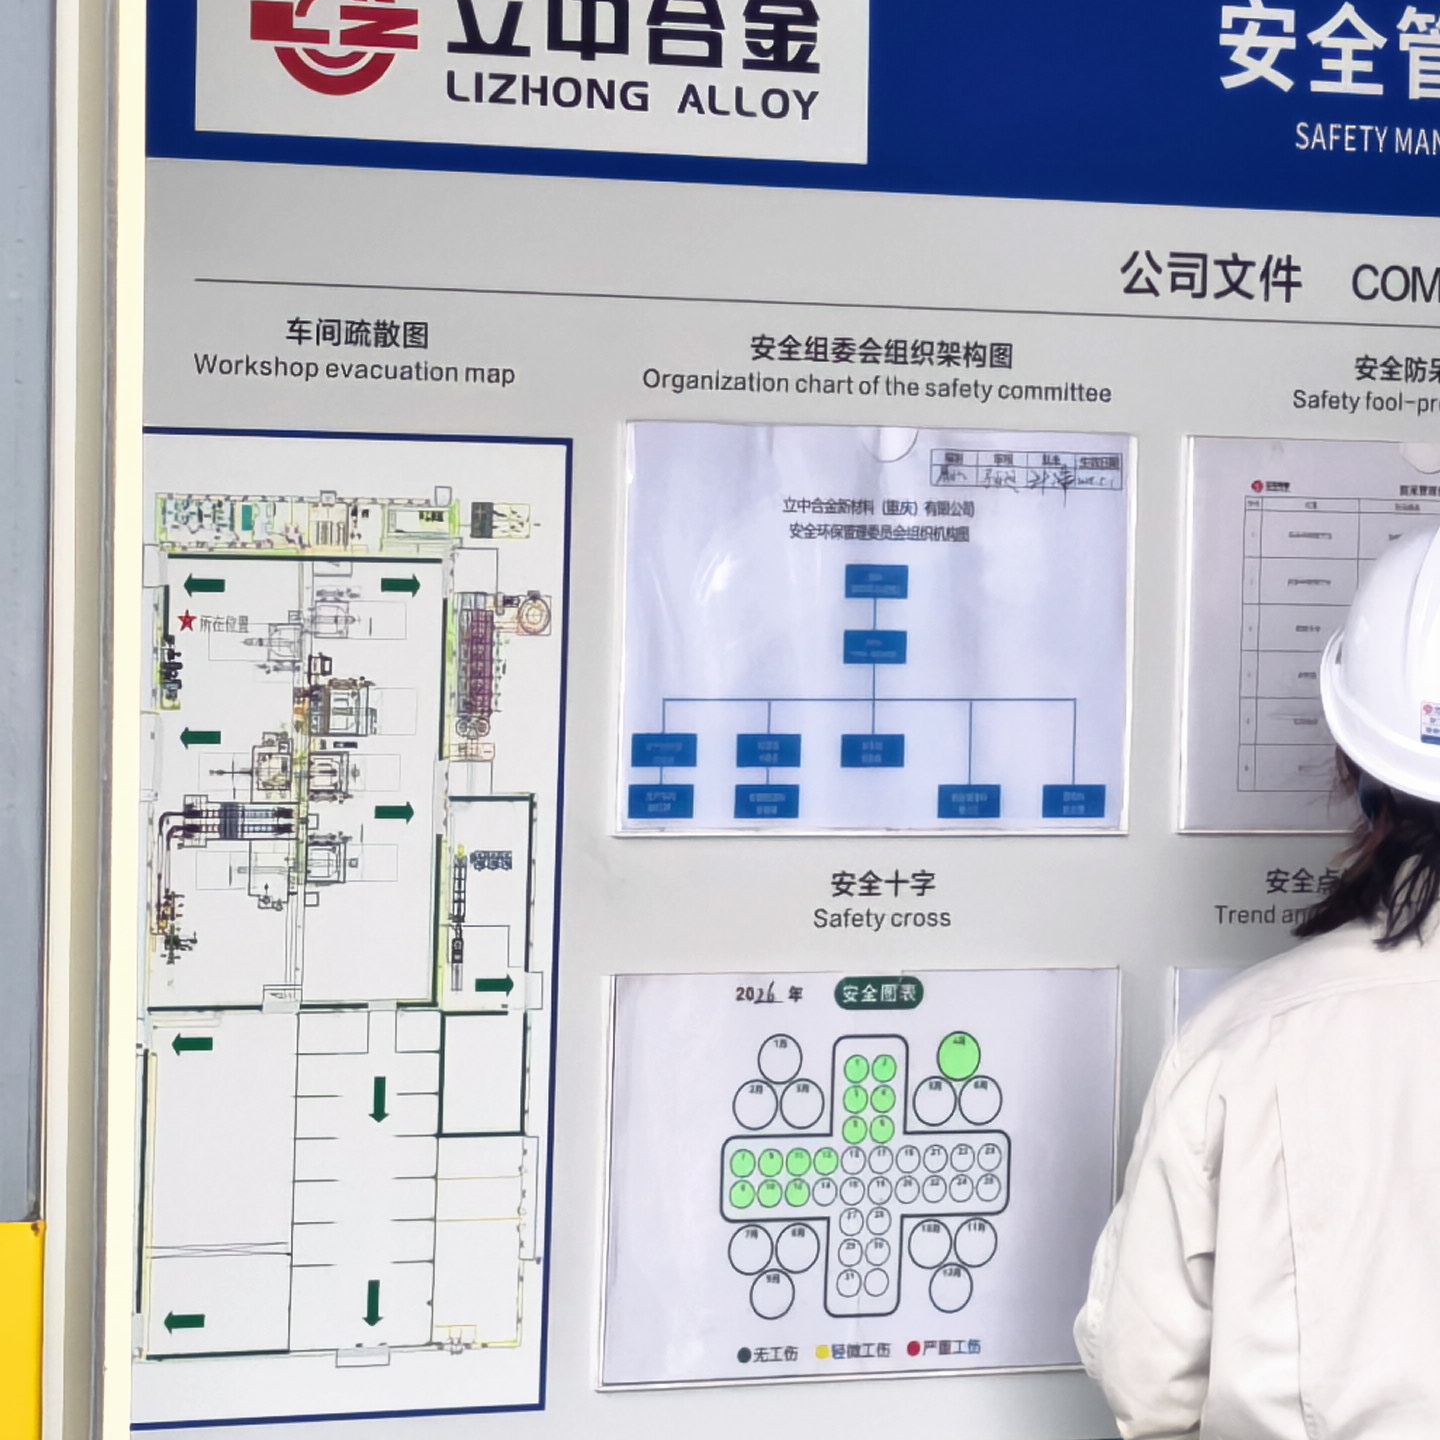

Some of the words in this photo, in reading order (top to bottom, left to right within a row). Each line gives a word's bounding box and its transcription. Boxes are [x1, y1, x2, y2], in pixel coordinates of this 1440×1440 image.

[446, 69, 650, 115] LIZHONG
[677, 80, 820, 122] ALLOY
[1295, 122, 1389, 154] SAFETY
[1120, 249, 1303, 303] 公司文件
[286, 316, 429, 350] 车间疏散图
[750, 333, 1013, 370] 安全组委会组织架构图
[194, 353, 319, 382] Workshop
[325, 359, 458, 383] evacuation
[464, 366, 516, 388] map
[643, 368, 789, 396] Organization
[795, 373, 853, 396] chart
[859, 375, 881, 397] of
[884, 375, 921, 398] the
[925, 378, 993, 404] safety
[998, 382, 1113, 405] committee
[1292, 389, 1360, 414] Safety
[200, 614, 249, 634] 所在位置
[830, 870, 936, 898] 安全十字
[1266, 868, 1348, 894] 安全点
[813, 906, 886, 933] Safety
[890, 909, 953, 930] cross
[1214, 905, 1276, 924] Trend
[842, 983, 918, 1005] 安全图表
[752, 1345, 799, 1363] 无工伤
[830, 1342, 892, 1359] 轻微工伤
[921, 1338, 982, 1356] 严重工伤
